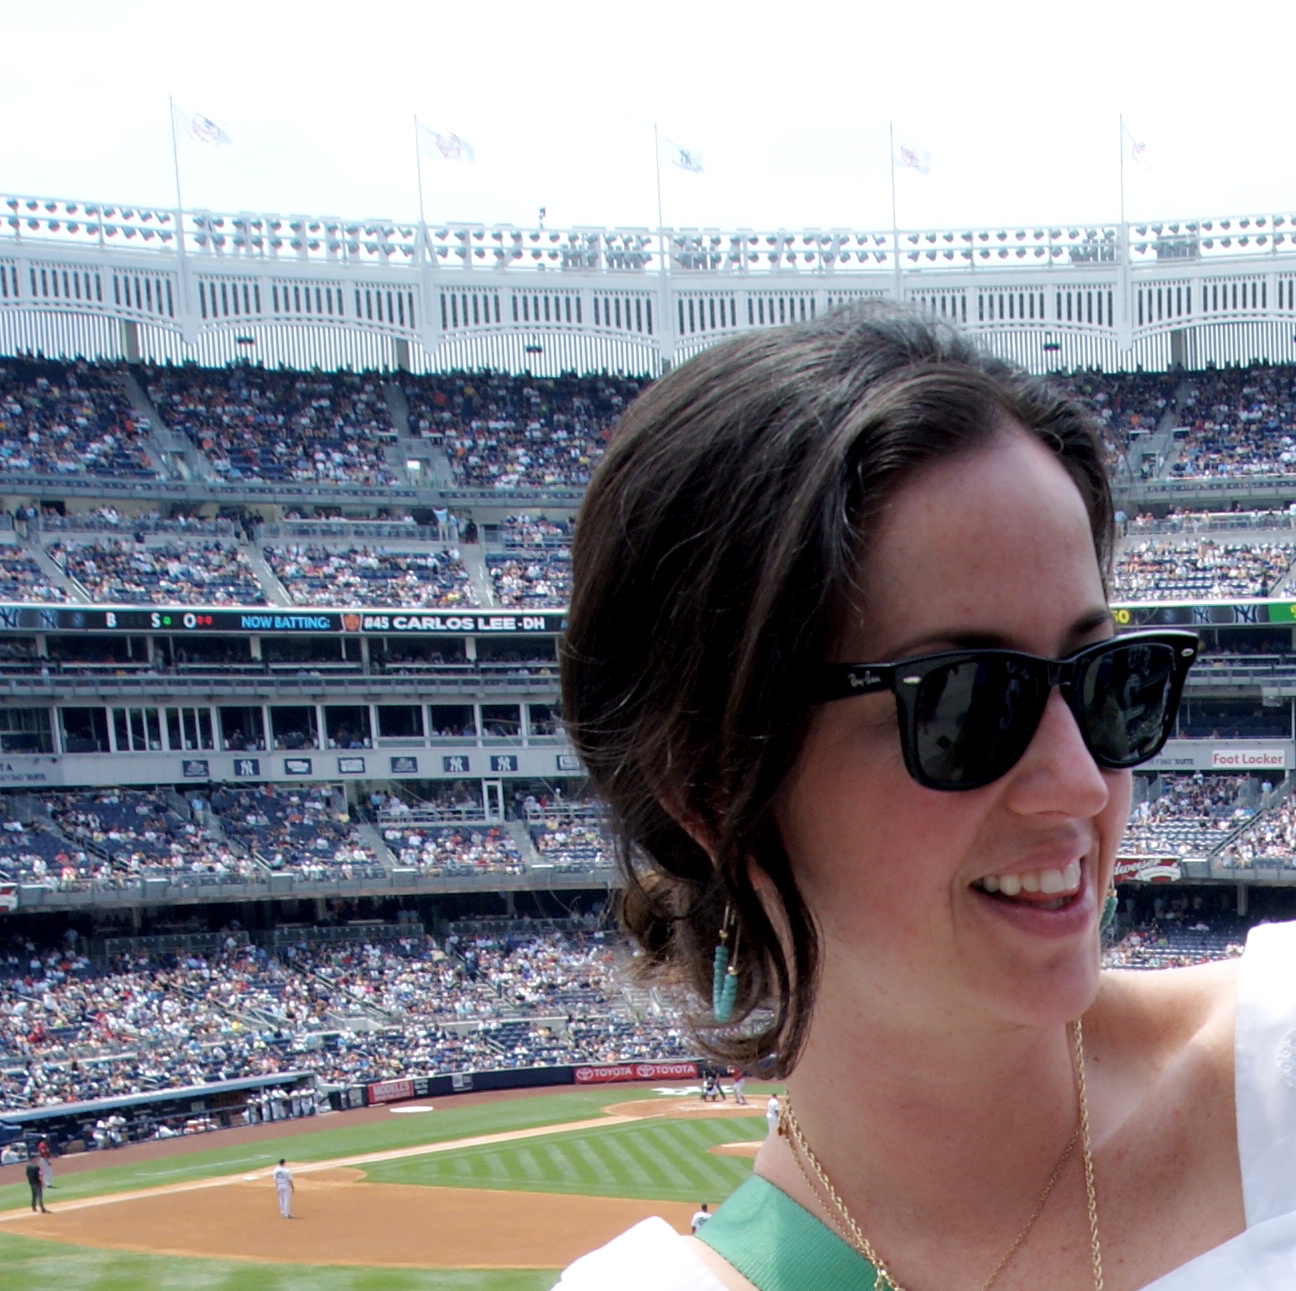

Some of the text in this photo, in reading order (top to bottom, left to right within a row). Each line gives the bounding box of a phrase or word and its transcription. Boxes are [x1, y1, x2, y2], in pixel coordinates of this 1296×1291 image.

[106, 612, 117, 628] B
[151, 612, 161, 628] S
[241, 615, 275, 629] NOW
[275, 616, 331, 629] BATTING:
[364, 616, 390, 630] #45
[392, 616, 475, 630] CARLOS
[1213, 753, 1283, 764] Foot Locker
[594, 1066, 633, 1077] TOYOTA
[655, 1064, 695, 1075] TOYOTA
